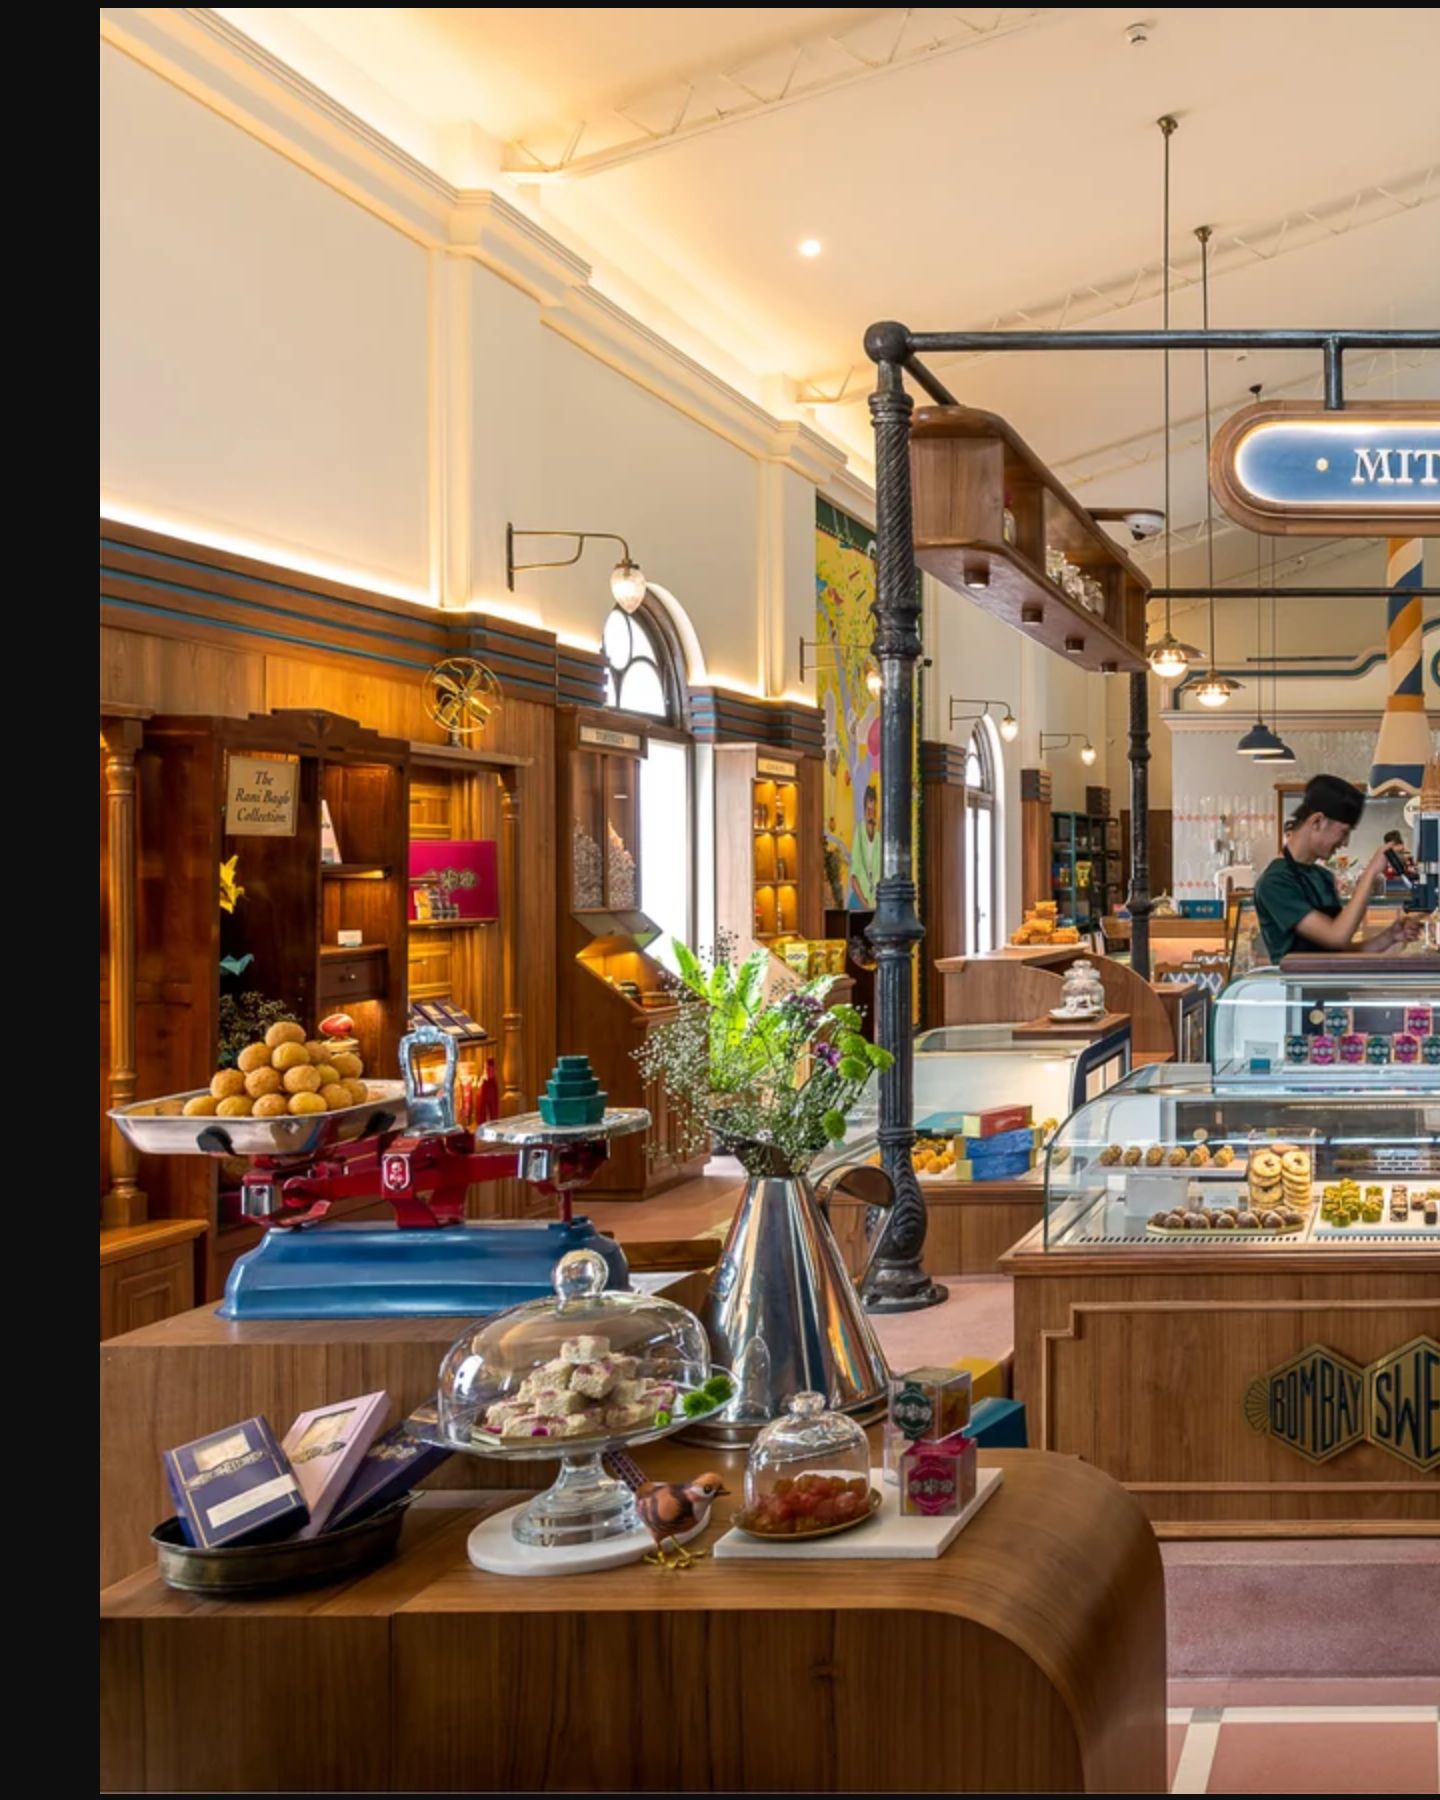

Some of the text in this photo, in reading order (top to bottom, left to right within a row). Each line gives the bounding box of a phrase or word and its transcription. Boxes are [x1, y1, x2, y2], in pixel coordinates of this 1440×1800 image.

[255, 770, 274, 786] The
[236, 787, 261, 803] Rani
[237, 807, 287, 823] Collection
[1271, 1357, 1362, 1452] BOMBAY
